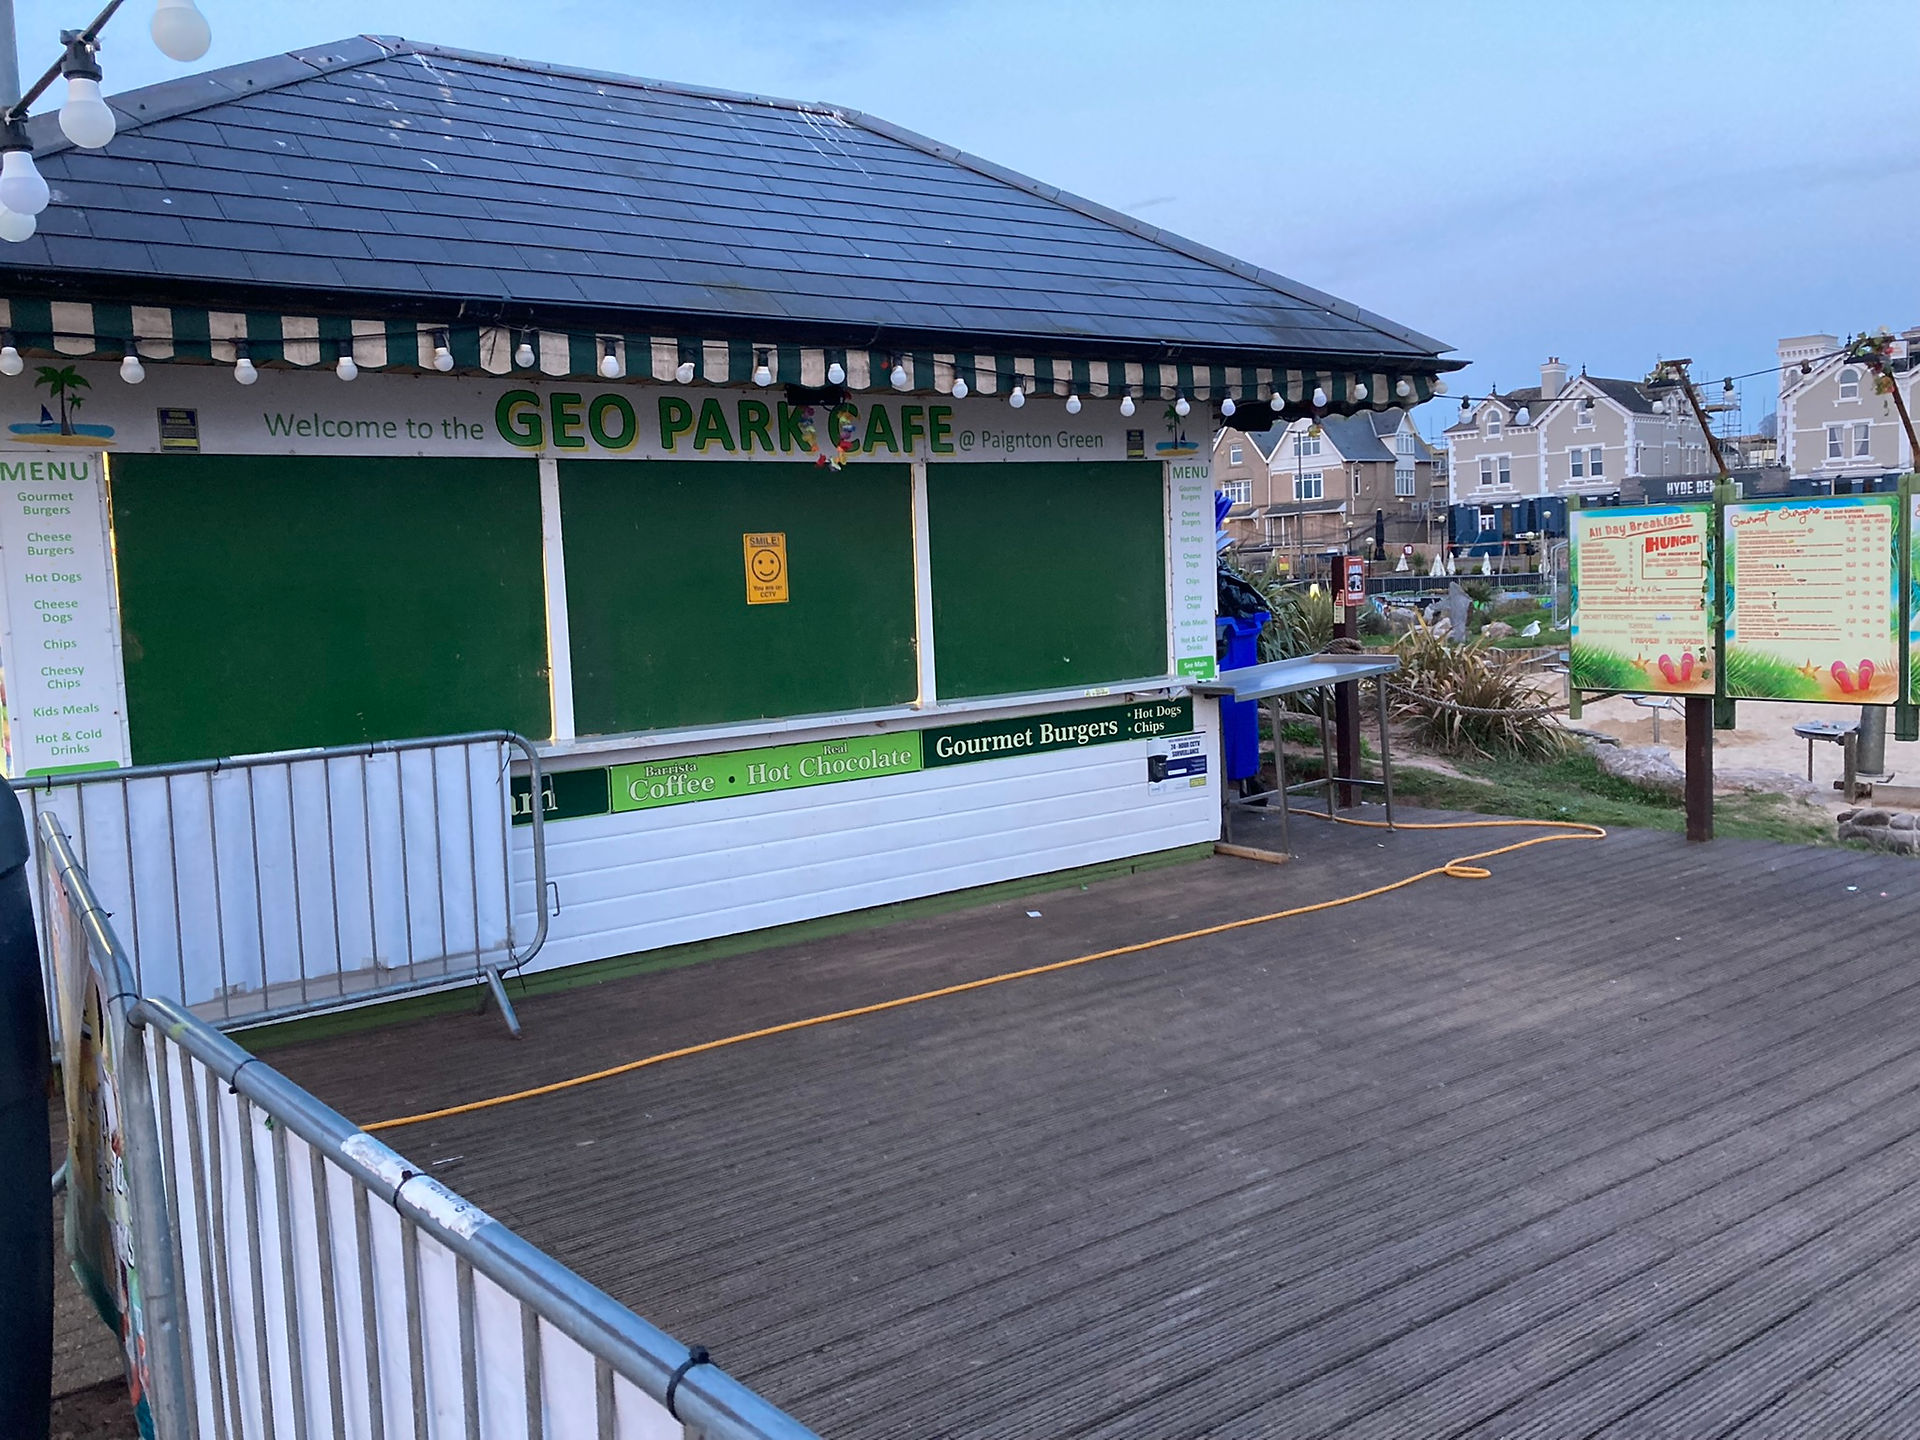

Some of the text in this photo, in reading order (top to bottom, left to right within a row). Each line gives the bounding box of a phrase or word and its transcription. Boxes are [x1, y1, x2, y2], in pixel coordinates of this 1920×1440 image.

[264, 389, 1104, 455] Welcome to the GEO PARK CAFE @ Paignton Green
[0, 461, 89, 482] MENU
[1172, 466, 1209, 479] MENU
[1667, 481, 1694, 495] HYDE
[17, 491, 74, 502] Gourmet
[23, 504, 71, 516] Burgers
[1778, 508, 1821, 524] Burgers
[1589, 514, 1692, 537] All Day Breakfasts
[27, 531, 72, 542] Cheese
[27, 545, 75, 557] Burgers
[25, 571, 82, 584] Hot Dogs
[1186, 577, 1200, 585] Chips
[34, 599, 79, 610] Cheese
[42, 612, 73, 624] Dogs
[43, 638, 77, 650] Chips
[41, 666, 85, 677] Cheesy
[47, 679, 81, 690] Chips
[33, 703, 100, 718] Kids Meals
[1133, 705, 1182, 719] Hot Dogs
[1134, 721, 1165, 734] Chips
[36, 729, 102, 744] Hot & Cold
[936, 719, 1118, 758] Gourmet Burgers
[51, 744, 90, 756] Drinks
[823, 743, 849, 756] Real
[629, 748, 912, 802] Coffee Hot Chocolate
[645, 761, 698, 777] Barrista
